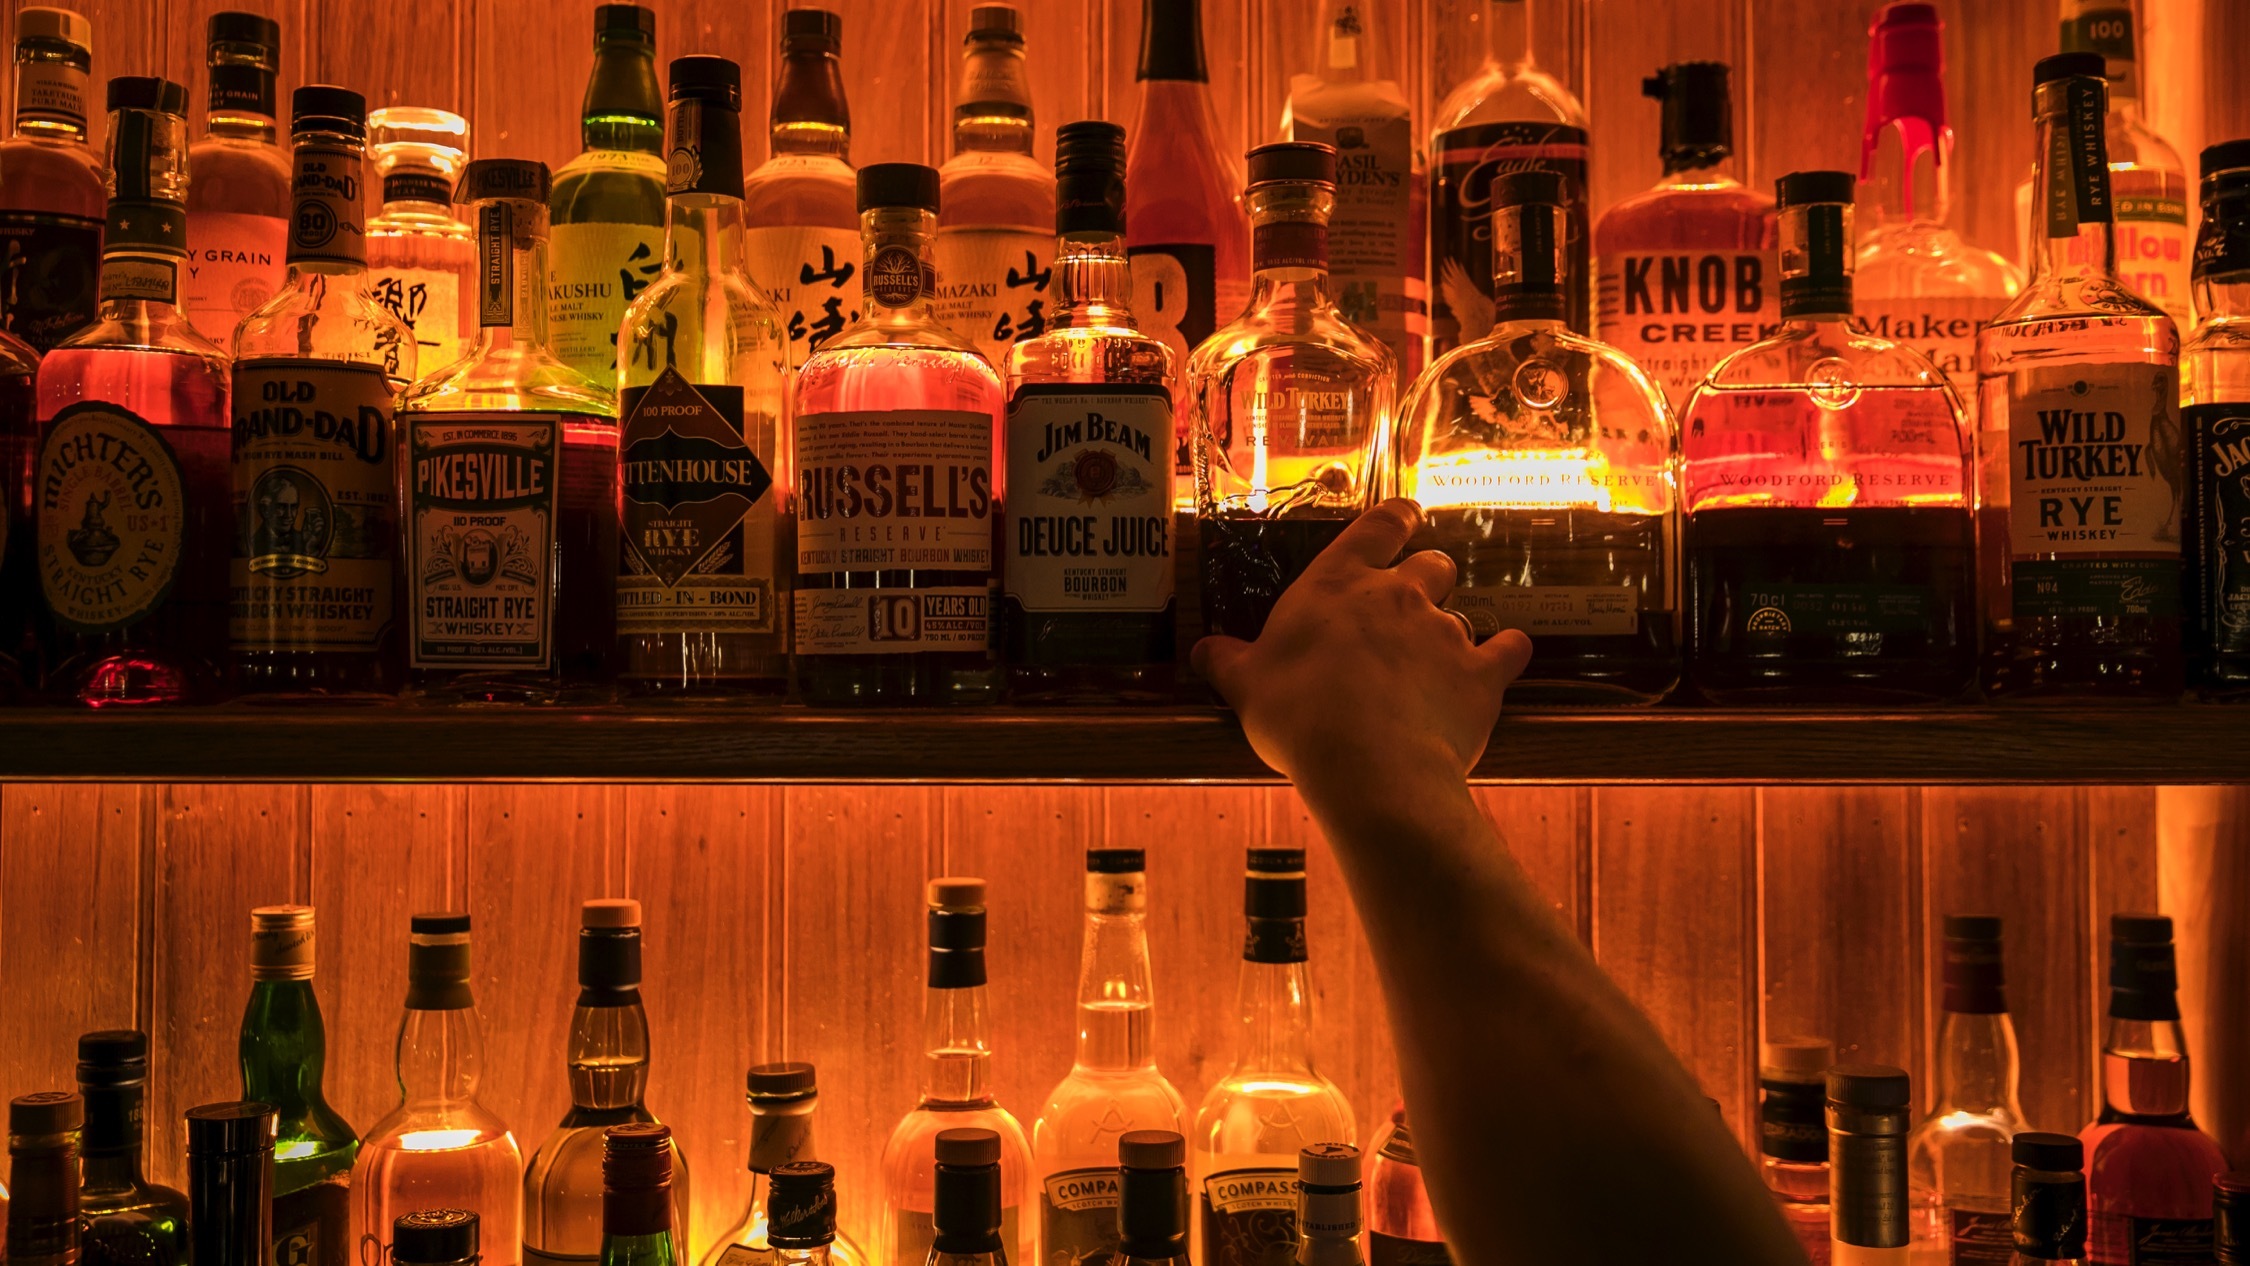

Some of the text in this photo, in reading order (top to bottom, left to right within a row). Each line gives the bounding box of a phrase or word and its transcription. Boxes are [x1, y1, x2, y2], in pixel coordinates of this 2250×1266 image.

[2089, 20, 2125, 40] 100
[2083, 88, 2102, 206] WHISKEY RYE
[671, 163, 690, 178] 100
[1337, 154, 1381, 171] ASIL
[476, 166, 535, 190] PIKESVILLE
[1336, 170, 1400, 187] YDEN'S
[294, 174, 356, 201] AND-DAD
[300, 213, 326, 230] 80
[491, 211, 500, 285] STRAIGHT RYE
[204, 250, 271, 265] GRAIN
[873, 275, 919, 287] RUSSELL'S
[1625, 255, 1763, 315] KNOB
[560, 303, 584, 312] MALT
[949, 301, 973, 309] MALT
[570, 312, 604, 321] WHISKY
[958, 311, 993, 319] WHISKY
[1297, 373, 1331, 384] CONVICTION
[263, 381, 317, 401] OLD
[1240, 387, 1350, 412] WILD TURKEY
[643, 405, 703, 417] 100 PROOF
[233, 405, 386, 464] RAND-DAD
[457, 431, 463, 439] IN
[465, 430, 499, 439] COMMERCE
[893, 431, 908, 439] They
[2037, 409, 2126, 445] WILD
[1037, 412, 1152, 463] JIM BEAM
[264, 452, 283, 460] RYE
[285, 451, 316, 460] MASH
[320, 452, 345, 461] BILL
[2018, 440, 2143, 481] TURKEY
[44, 432, 163, 510] MICHTER'S
[417, 453, 545, 500] PIKESVILLE
[1433, 473, 1656, 488] WOODFORD RESERVE
[1721, 472, 1951, 487] WOODFORD RESERVE
[338, 491, 362, 500] EST.
[800, 464, 988, 521] RUSSELL'S
[2040, 496, 2123, 528] RYE
[470, 516, 506, 526] PROOF
[648, 519, 694, 528] STRAIGHT
[644, 528, 700, 548] RYE
[840, 526, 942, 542] RESERVE
[1019, 516, 1169, 557] DEUCE JUICE
[2047, 530, 2117, 541] WHISKEY
[649, 547, 692, 556] WHISKY
[801, 549, 989, 564] KENTUCKY STRAIGHT BOURBON WHISKEY
[45, 538, 164, 605] STRAIGHT RYE
[68, 564, 123, 583] KENTUCKY
[1064, 577, 1127, 592] BOURBON
[286, 587, 374, 603] STRAIGHT
[675, 591, 757, 605] IN BOND
[1457, 595, 1496, 607] 700mL
[1750, 593, 1785, 607] 70cl
[68, 605, 124, 620] WHISKEY
[287, 604, 374, 621] WHISKEY
[426, 597, 535, 619] STRAIGHT RYE
[926, 596, 986, 616] YEARS OLD
[2126, 605, 2149, 614] 700mL
[875, 598, 916, 637] 10
[1552, 618, 1593, 627] ALC/VOL
[445, 622, 514, 635] WHISKEY
[1217, 1180, 1298, 1200] COMPASS
[1231, 1201, 1263, 1210] SCOTCH
